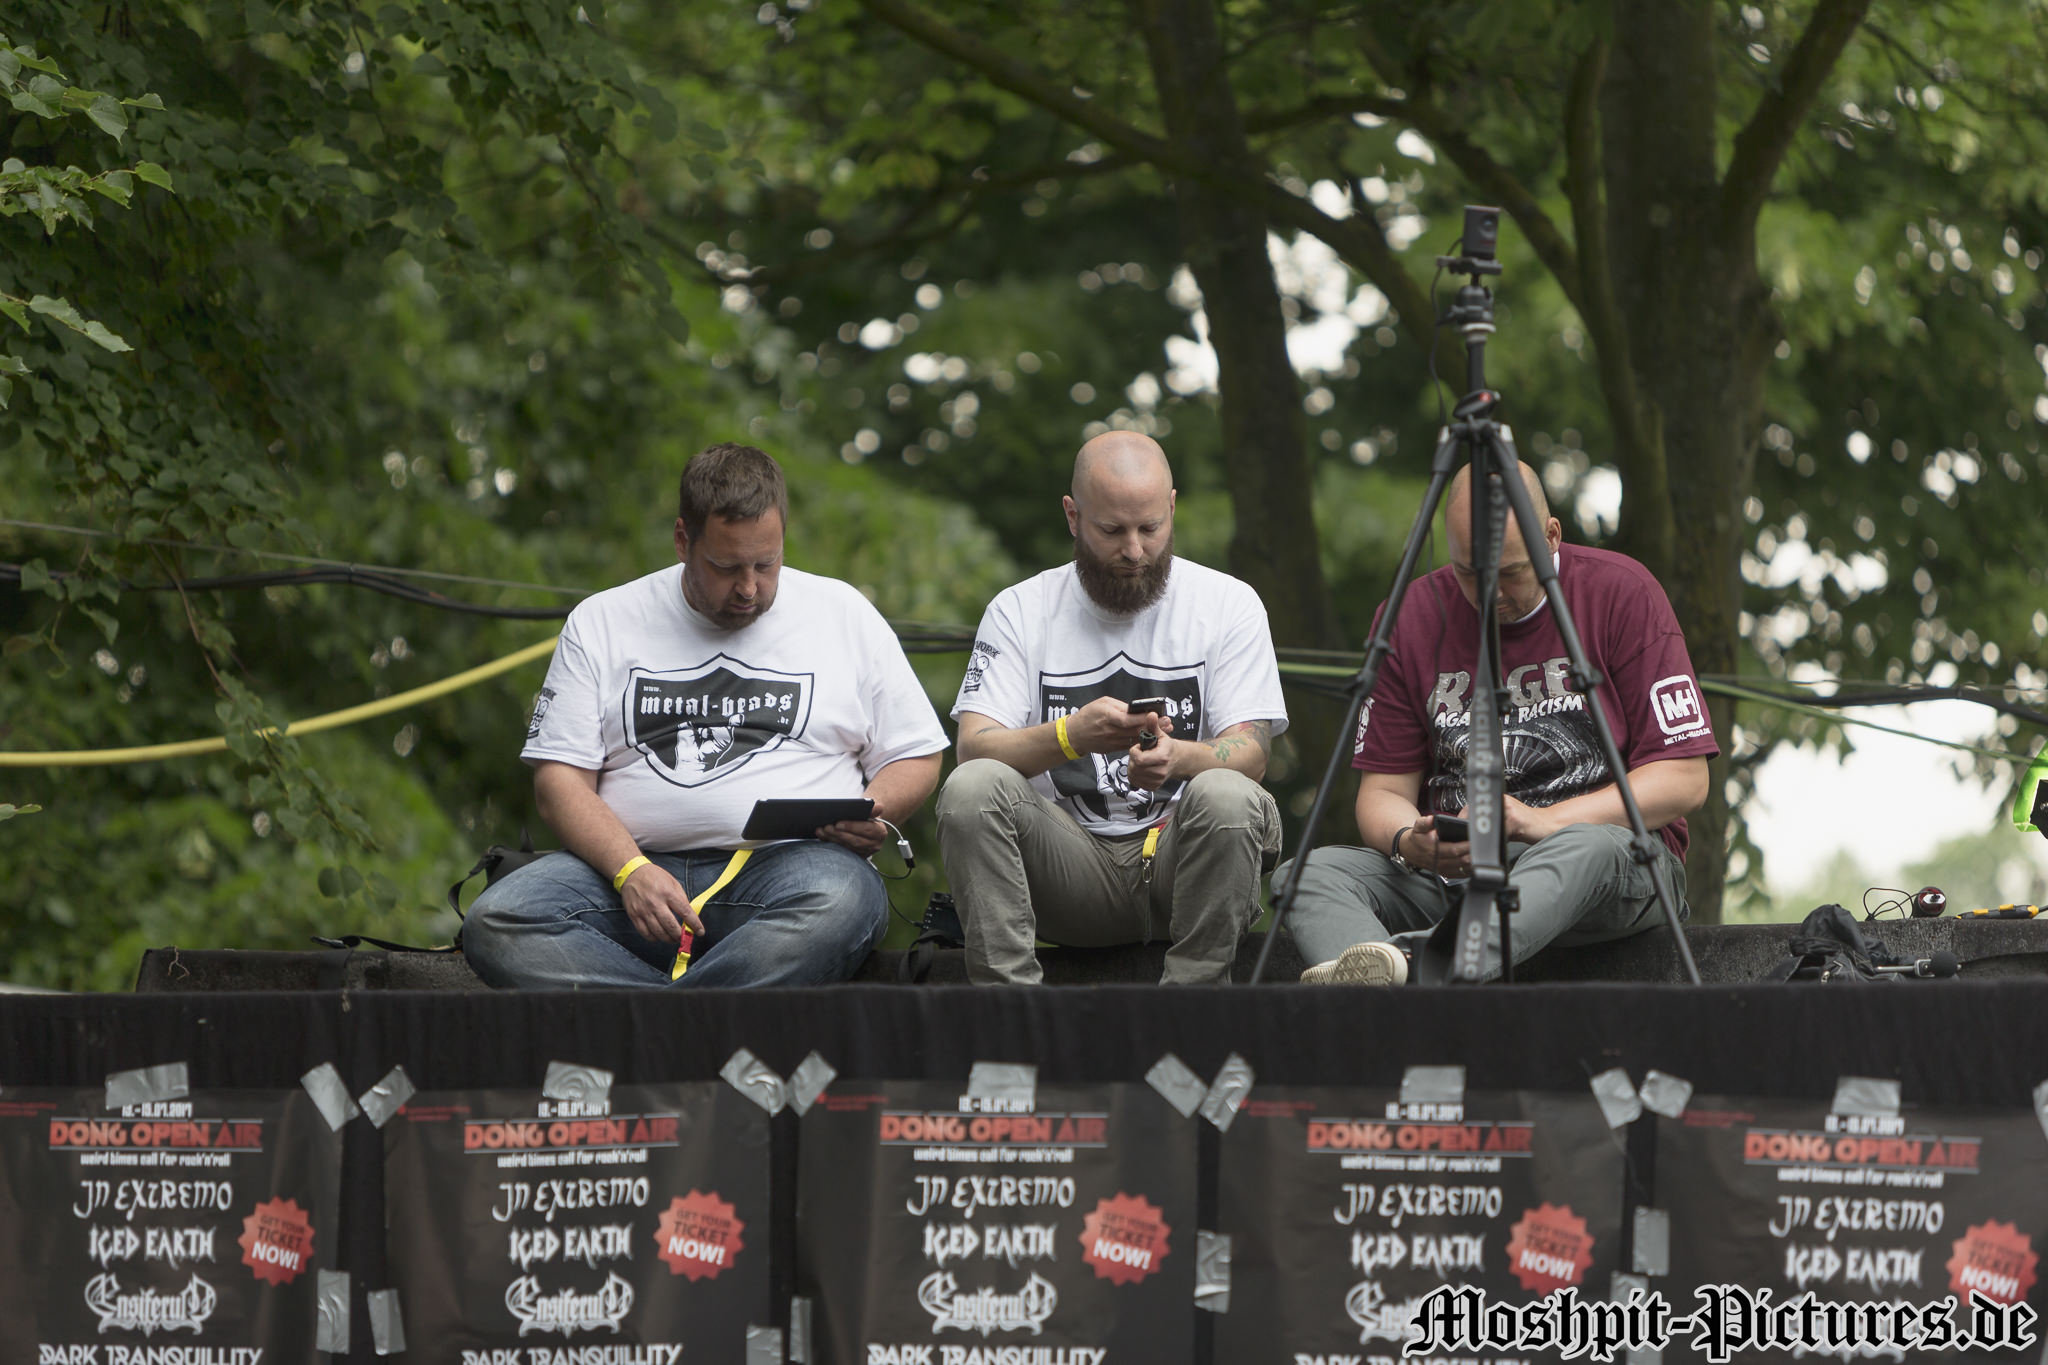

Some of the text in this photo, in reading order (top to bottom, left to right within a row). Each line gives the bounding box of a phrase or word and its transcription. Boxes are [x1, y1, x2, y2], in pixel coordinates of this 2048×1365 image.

[1426, 657, 1584, 718] RGE
[640, 692, 793, 718] metal-heads
[1518, 694, 1585, 724] RACISM
[1660, 688, 1698, 721] MH
[50, 1120, 263, 1147] DONG OPEN AIR
[464, 1117, 679, 1149] DONG OPEN AIR
[880, 1114, 1107, 1143] DONG OPEN AIR
[1307, 1121, 1534, 1152] DONG OPEN AIR
[114, 1179, 233, 1221] EXTREMO
[534, 1177, 649, 1222] EXTREMO
[952, 1175, 1076, 1219] EXTREMO
[1379, 1183, 1502, 1228] EXTREMO
[675, 1221, 728, 1245] TICKET
[1815, 1196, 1944, 1241] EXTREMO
[88, 1225, 217, 1270] ICED EARTH
[258, 1226, 302, 1249] TICKET
[509, 1223, 634, 1272] ICED EARTH
[667, 1235, 726, 1265] NOW!
[923, 1220, 1058, 1269] ICED EARTH
[251, 1240, 300, 1271] NOW!
[1093, 1238, 1152, 1270] NOW!
[1351, 1231, 1487, 1280] ICED EARTH
[1519, 1249, 1575, 1281] NOW!
[1785, 1243, 1841, 1290] ICED
[1846, 1247, 1925, 1294] EARTH
